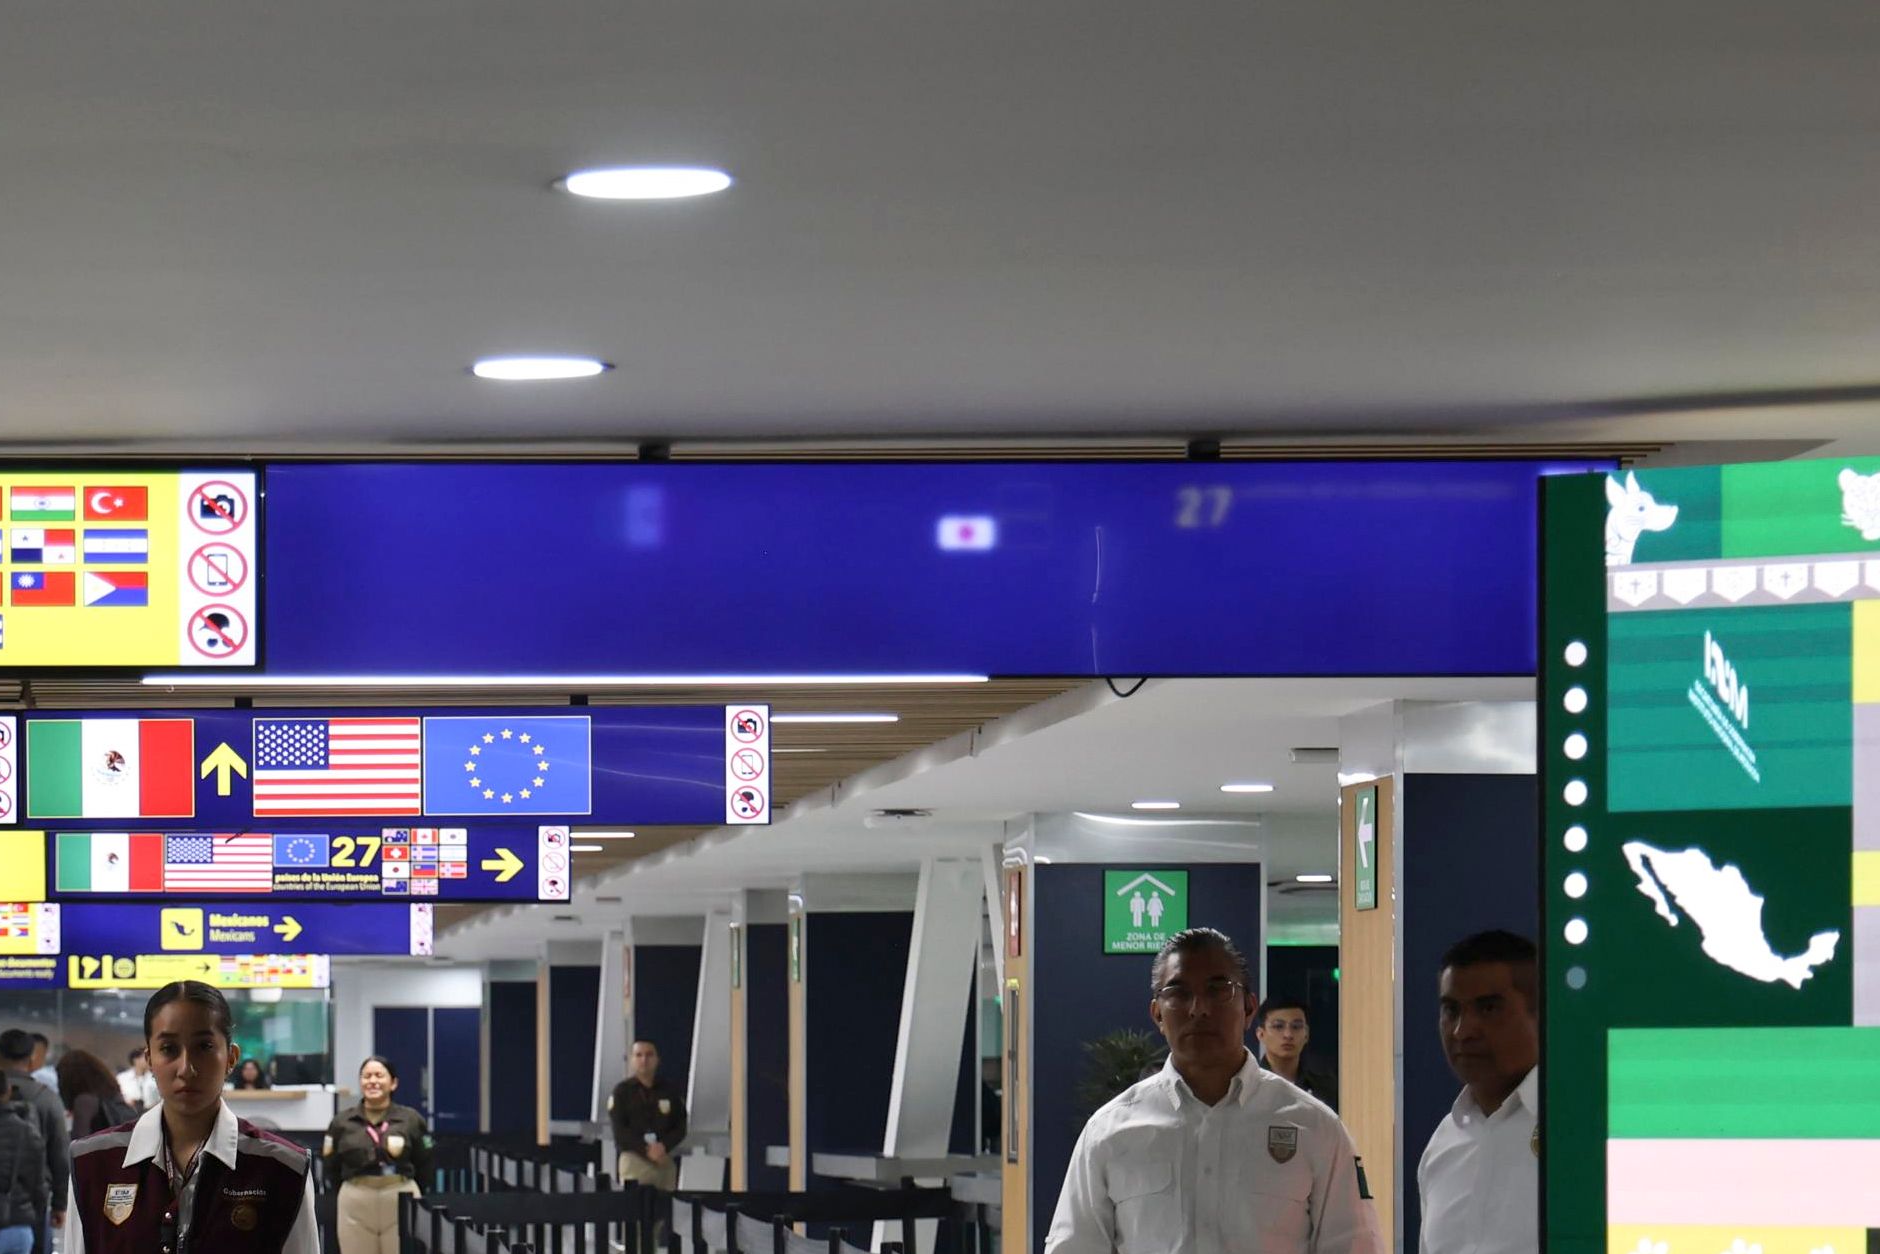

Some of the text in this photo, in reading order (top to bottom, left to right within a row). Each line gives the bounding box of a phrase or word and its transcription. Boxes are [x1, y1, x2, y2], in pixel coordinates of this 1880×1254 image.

[331, 835, 382, 868] 27
[209, 914, 270, 927] Mexicanos
[209, 929, 256, 942] Mexicans
[1127, 932, 1152, 941] ZONA
[1111, 941, 1145, 950] MENOR
